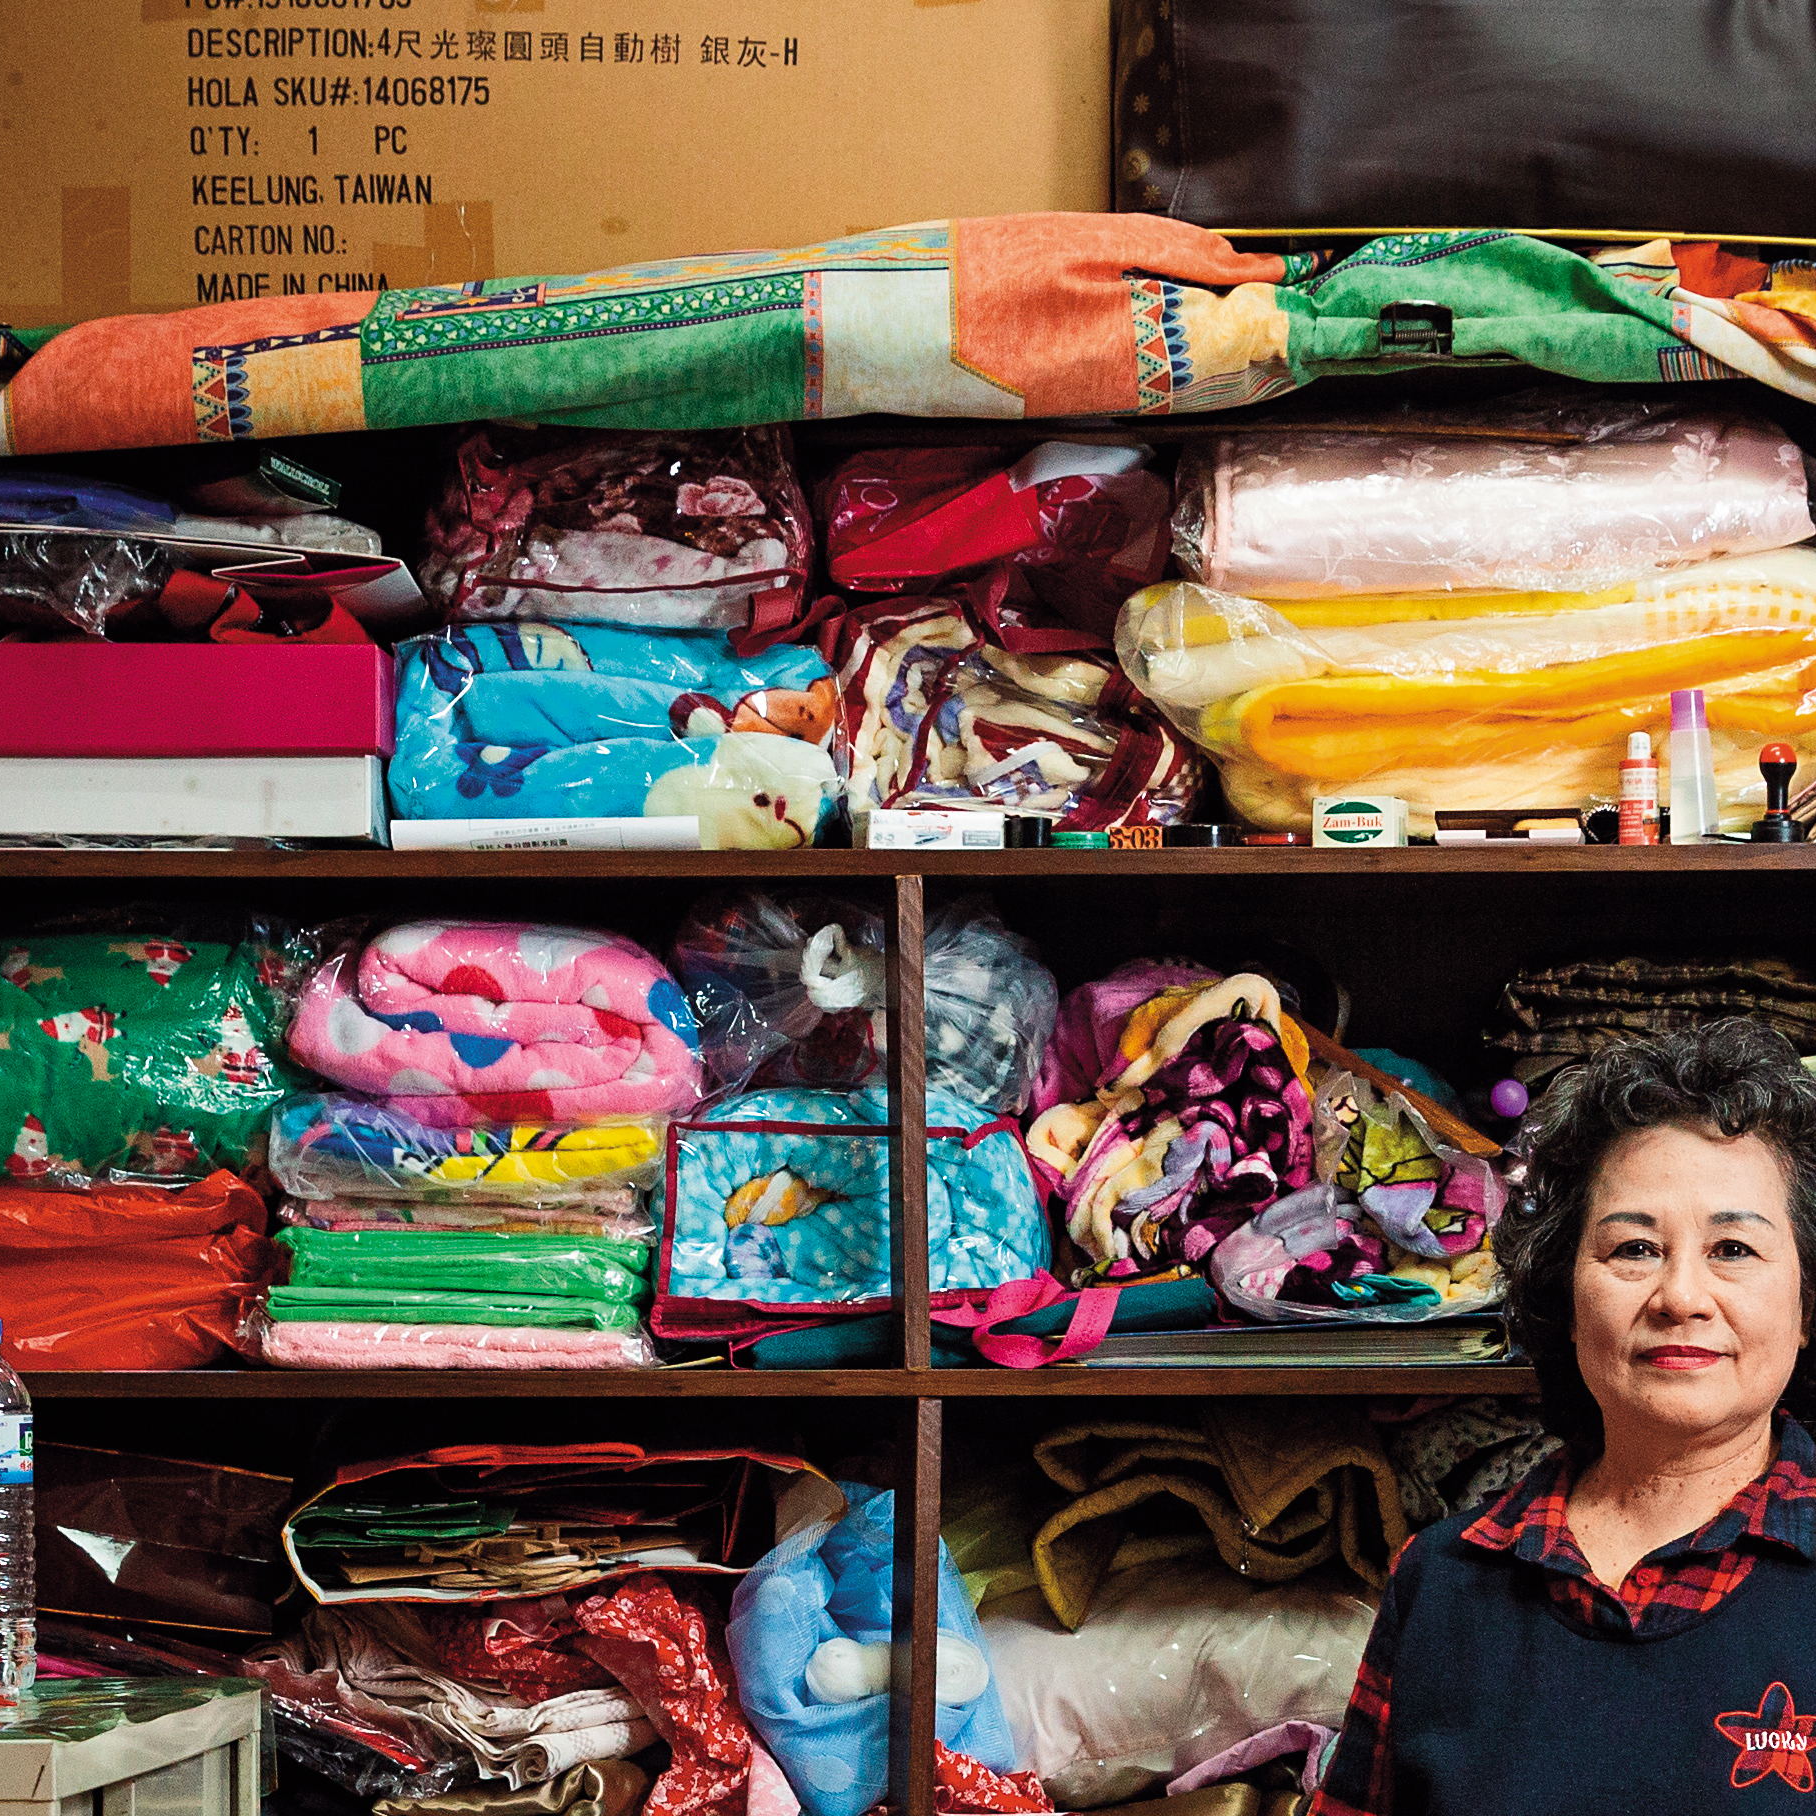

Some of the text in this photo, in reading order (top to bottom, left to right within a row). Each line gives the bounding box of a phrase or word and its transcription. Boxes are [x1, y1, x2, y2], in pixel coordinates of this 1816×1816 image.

[700, 35, 799, 68] 銀灰-H
[188, 75, 490, 107] HOLA SKU#:14068175
[190, 125, 407, 157] Q'TY: 1 PC
[335, 173, 432, 205] TAIWAN
[194, 224, 347, 255] CARTON NO.:
[197, 272, 390, 303] MADE IN CHINA
[1323, 815, 1383, 829] Zam-Buk
[1745, 1731, 1807, 1751] LUCKY
